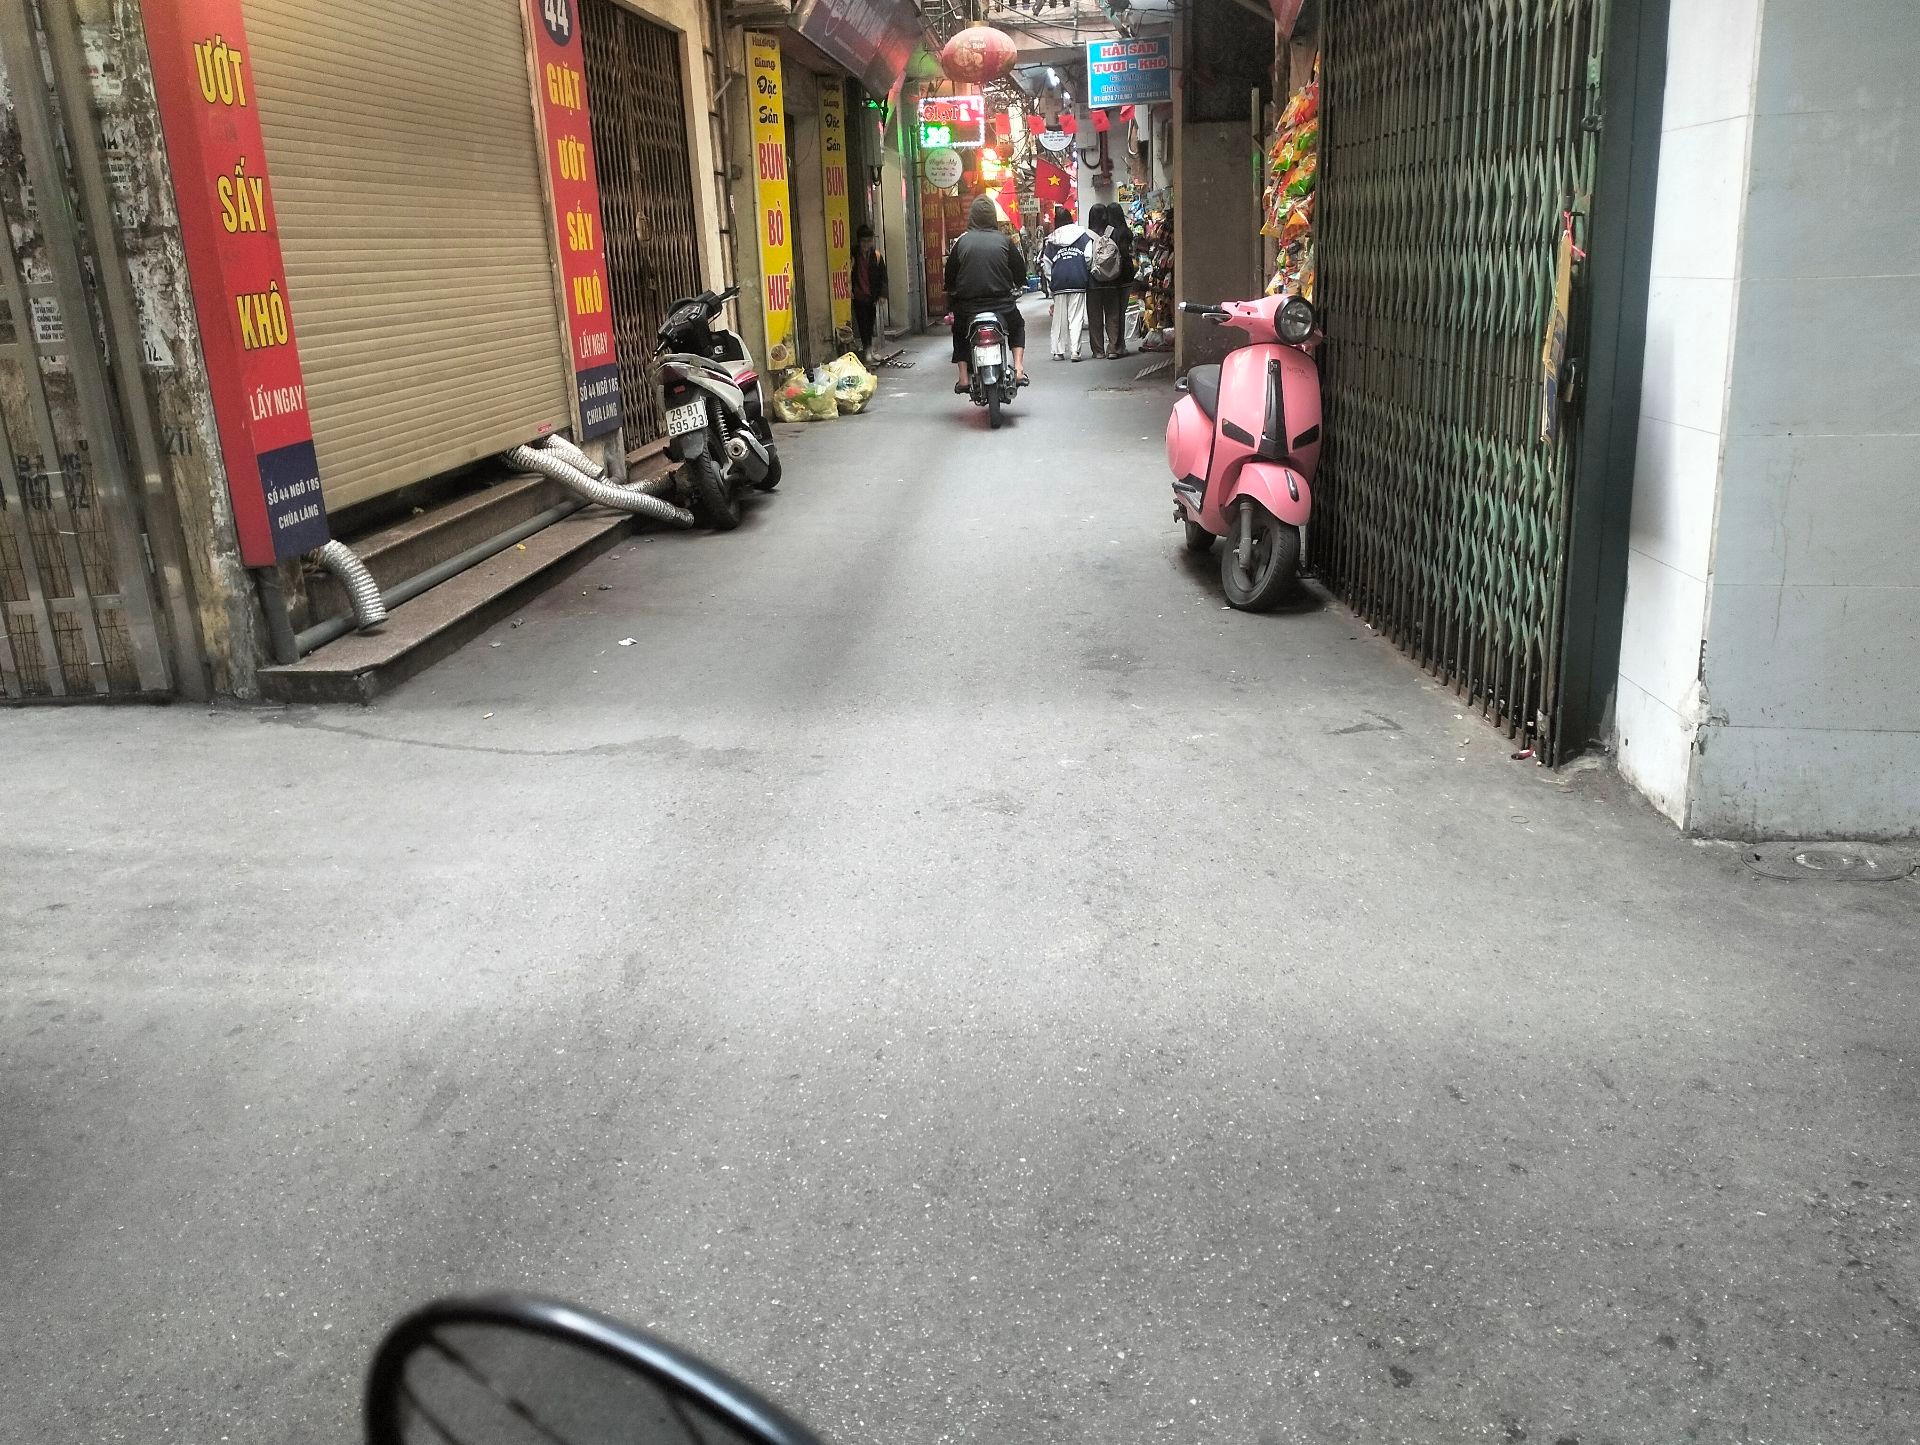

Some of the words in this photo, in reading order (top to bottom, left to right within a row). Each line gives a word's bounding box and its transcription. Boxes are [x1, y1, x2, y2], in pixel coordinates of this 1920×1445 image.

[544, 0, 569, 36] 44
[193, 33, 247, 107] ƯỚT
[546, 61, 581, 116] GIẶT
[757, 75, 777, 99] Đặc
[759, 105, 779, 124] Sản
[557, 134, 587, 181] ƯỚT
[758, 135, 785, 180] BÚN
[217, 157, 267, 233] SẤY
[826, 160, 845, 196] BÚN
[566, 199, 594, 251] SẤY
[767, 201, 785, 247] BÒ
[573, 269, 603, 315] KHÔ
[767, 263, 790, 311] HUẾ
[832, 262, 850, 301] HUẾ
[236, 280, 289, 350] KHÔ
[579, 329, 593, 358] LẤY
[592, 332, 608, 355] NGAY
[250, 384, 273, 421] LẤY
[274, 384, 304, 415] NGAY
[588, 383, 596, 399] 44
[608, 377, 619, 393] 185
[670, 403, 699, 422] 29-B1
[670, 414, 705, 435] 595.23
[267, 486, 279, 506] SỐ
[279, 487, 290, 501] 44
[306, 477, 320, 491] 185
[278, 509, 300, 530] CHÙA
